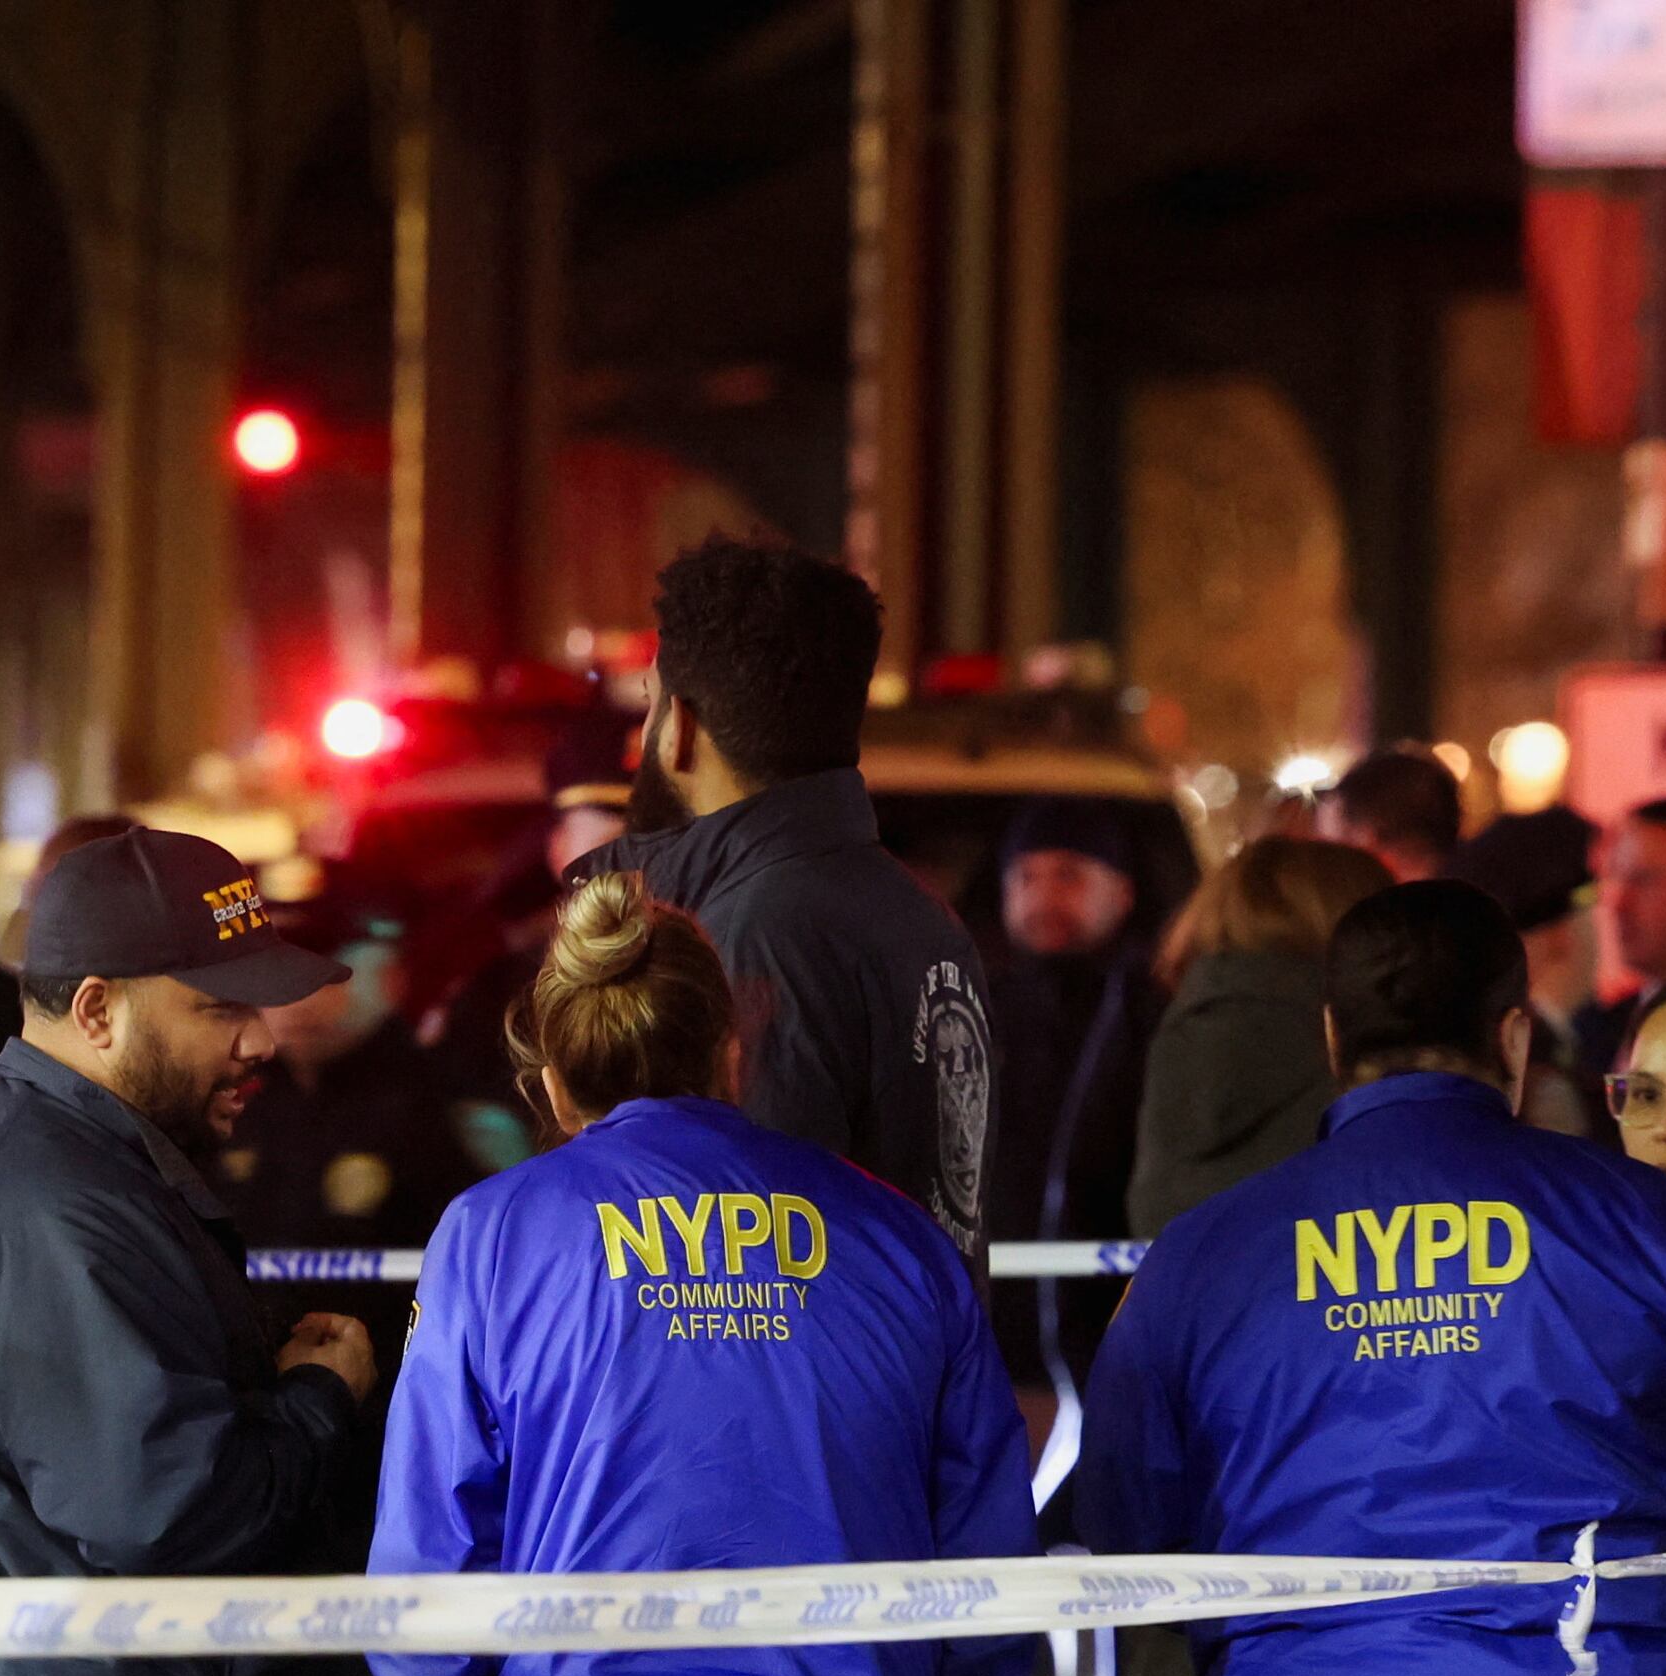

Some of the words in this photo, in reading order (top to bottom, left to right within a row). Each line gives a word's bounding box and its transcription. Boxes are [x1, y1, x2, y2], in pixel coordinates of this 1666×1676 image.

[213, 900, 246, 924] CRIME
[595, 1192, 827, 1281] NYPD
[1294, 1200, 1532, 1302] NYPD
[638, 1282, 810, 1310] COMMUNITY
[1325, 1292, 1505, 1332] COMMUNITY
[667, 1313, 791, 1342] AFFAIRS
[1353, 1325, 1481, 1362] AFFAIRS
